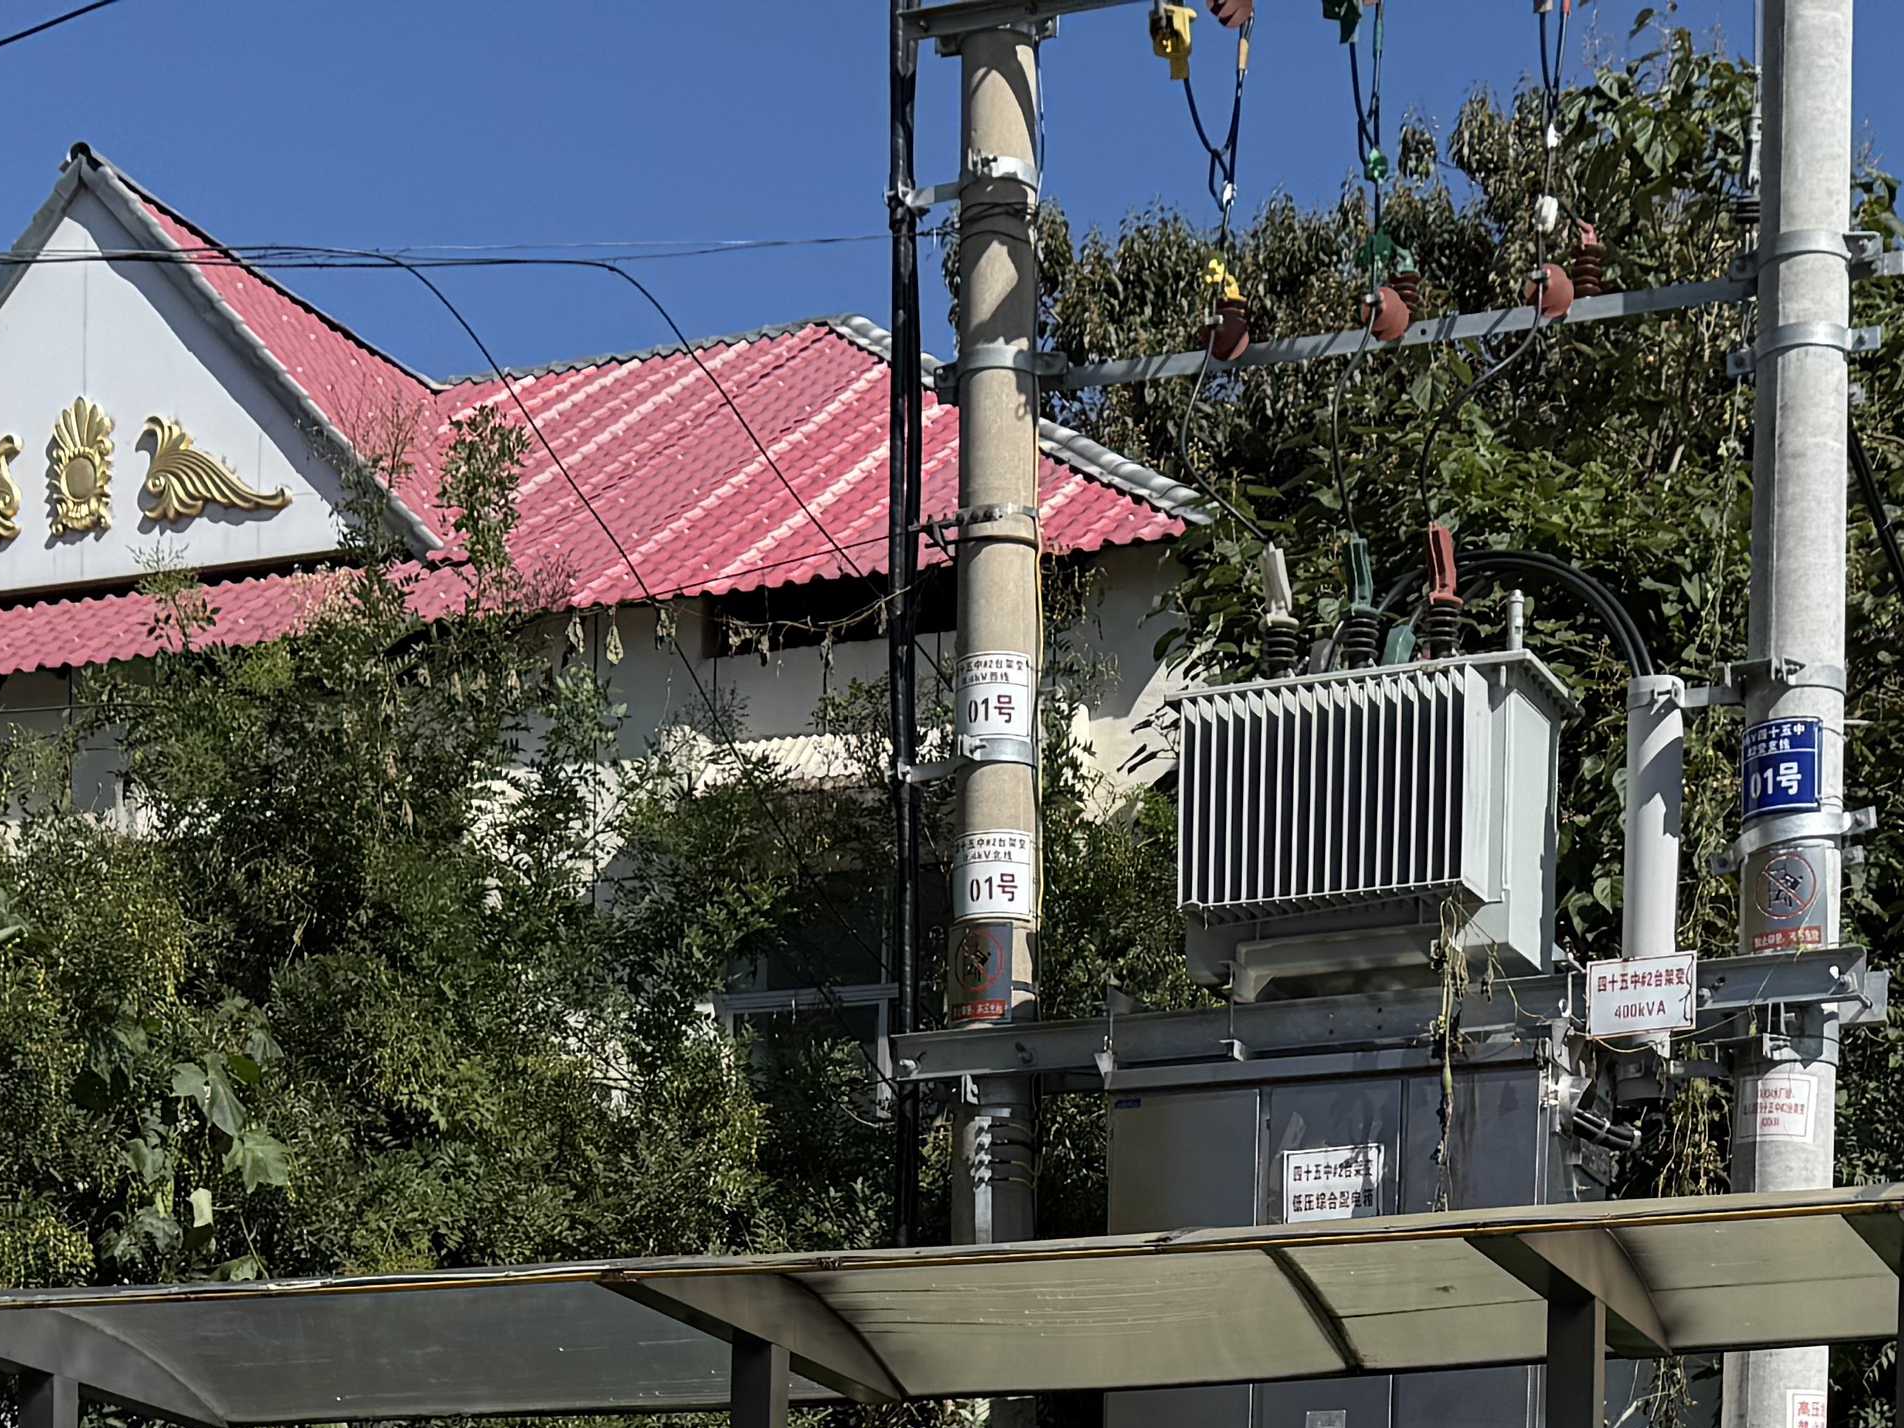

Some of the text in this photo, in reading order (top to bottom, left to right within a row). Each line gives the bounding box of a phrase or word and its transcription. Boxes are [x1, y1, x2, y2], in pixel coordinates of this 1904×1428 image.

[968, 694, 1015, 724] 01号
[1750, 762, 1802, 799] 01号
[969, 872, 1019, 902] 01号
[1614, 999, 1667, 1020] 400kVA
